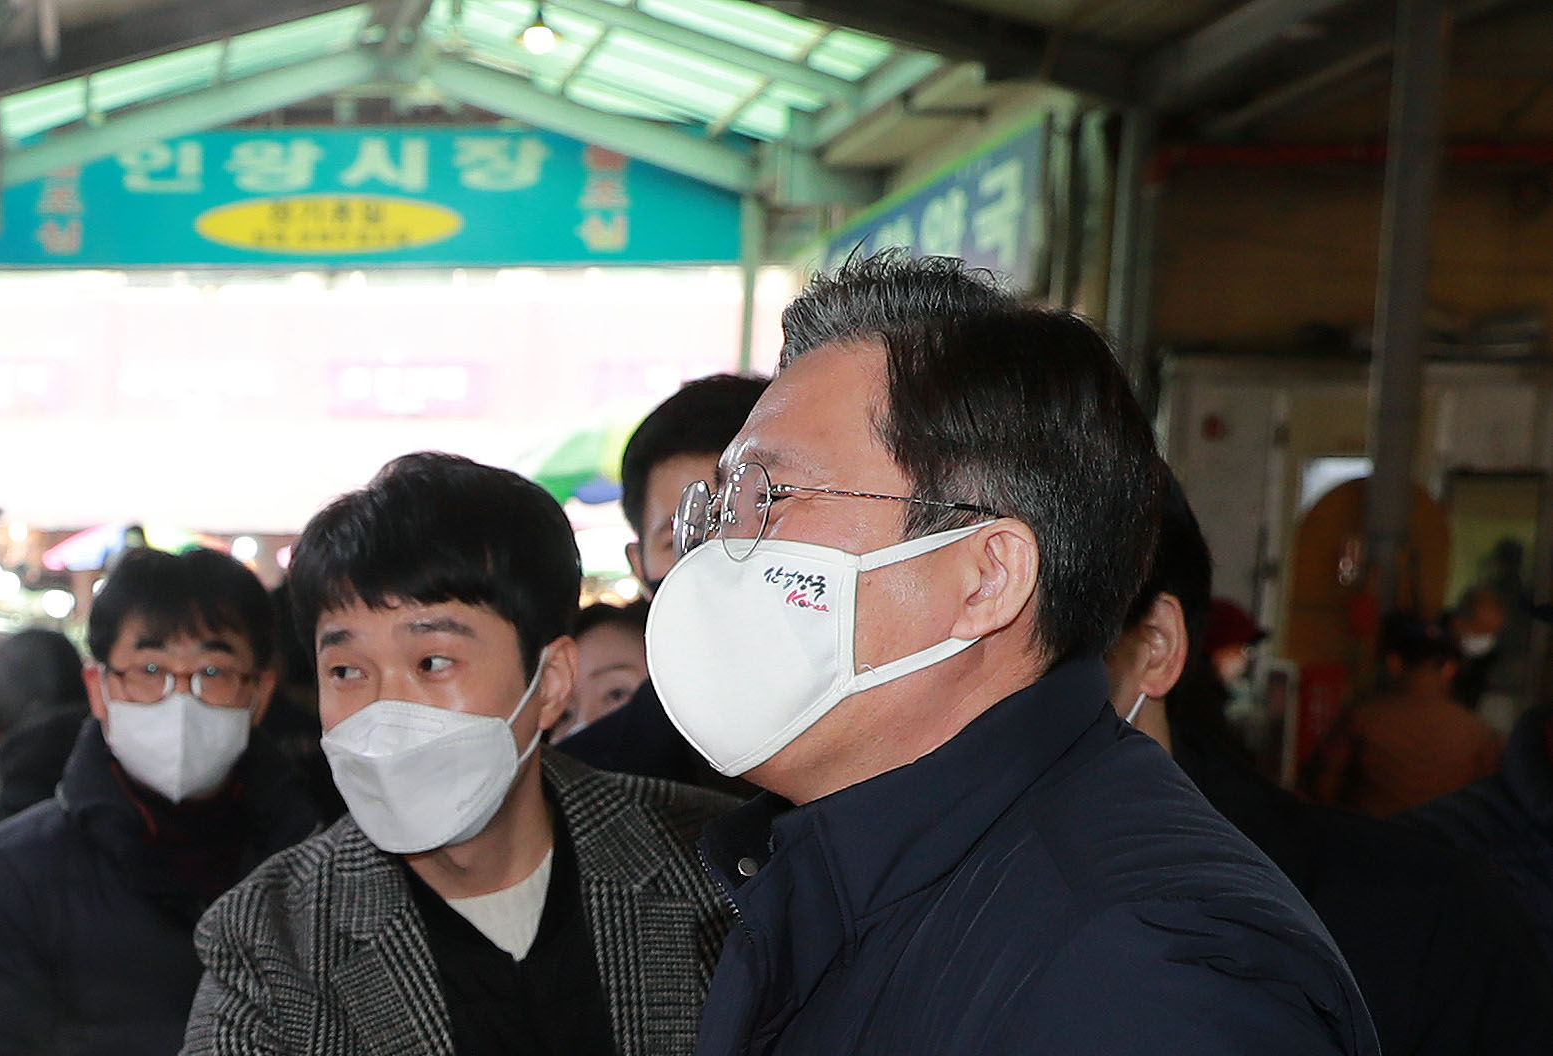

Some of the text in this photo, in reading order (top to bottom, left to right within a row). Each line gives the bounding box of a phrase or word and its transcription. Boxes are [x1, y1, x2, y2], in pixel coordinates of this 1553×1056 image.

[115, 136, 551, 193] 인왕시장
[763, 566, 827, 602] 산업강국
[785, 589, 830, 613] Korea
